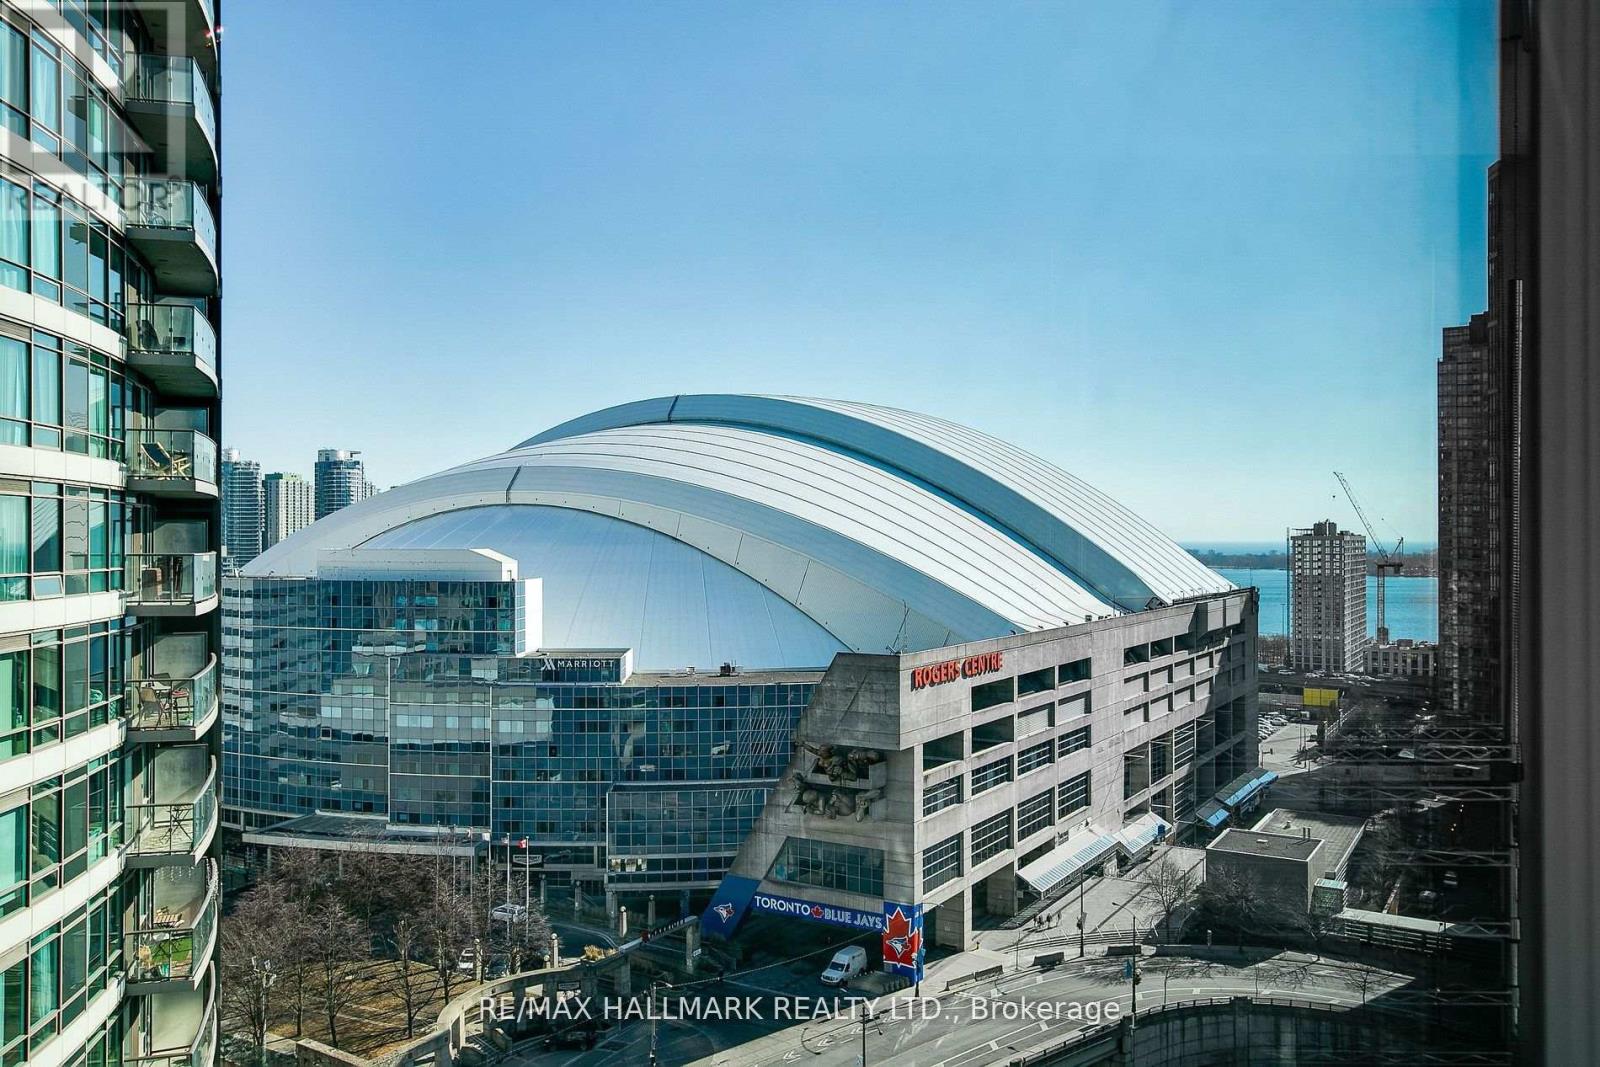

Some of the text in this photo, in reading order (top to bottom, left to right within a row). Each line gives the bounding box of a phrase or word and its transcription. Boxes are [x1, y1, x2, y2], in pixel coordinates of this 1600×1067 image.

[557, 660, 614, 668] MARRIOTT
[913, 653, 1002, 690] ROGERS CENTRE
[755, 895, 882, 929] TORONTO BLUE JAYS
